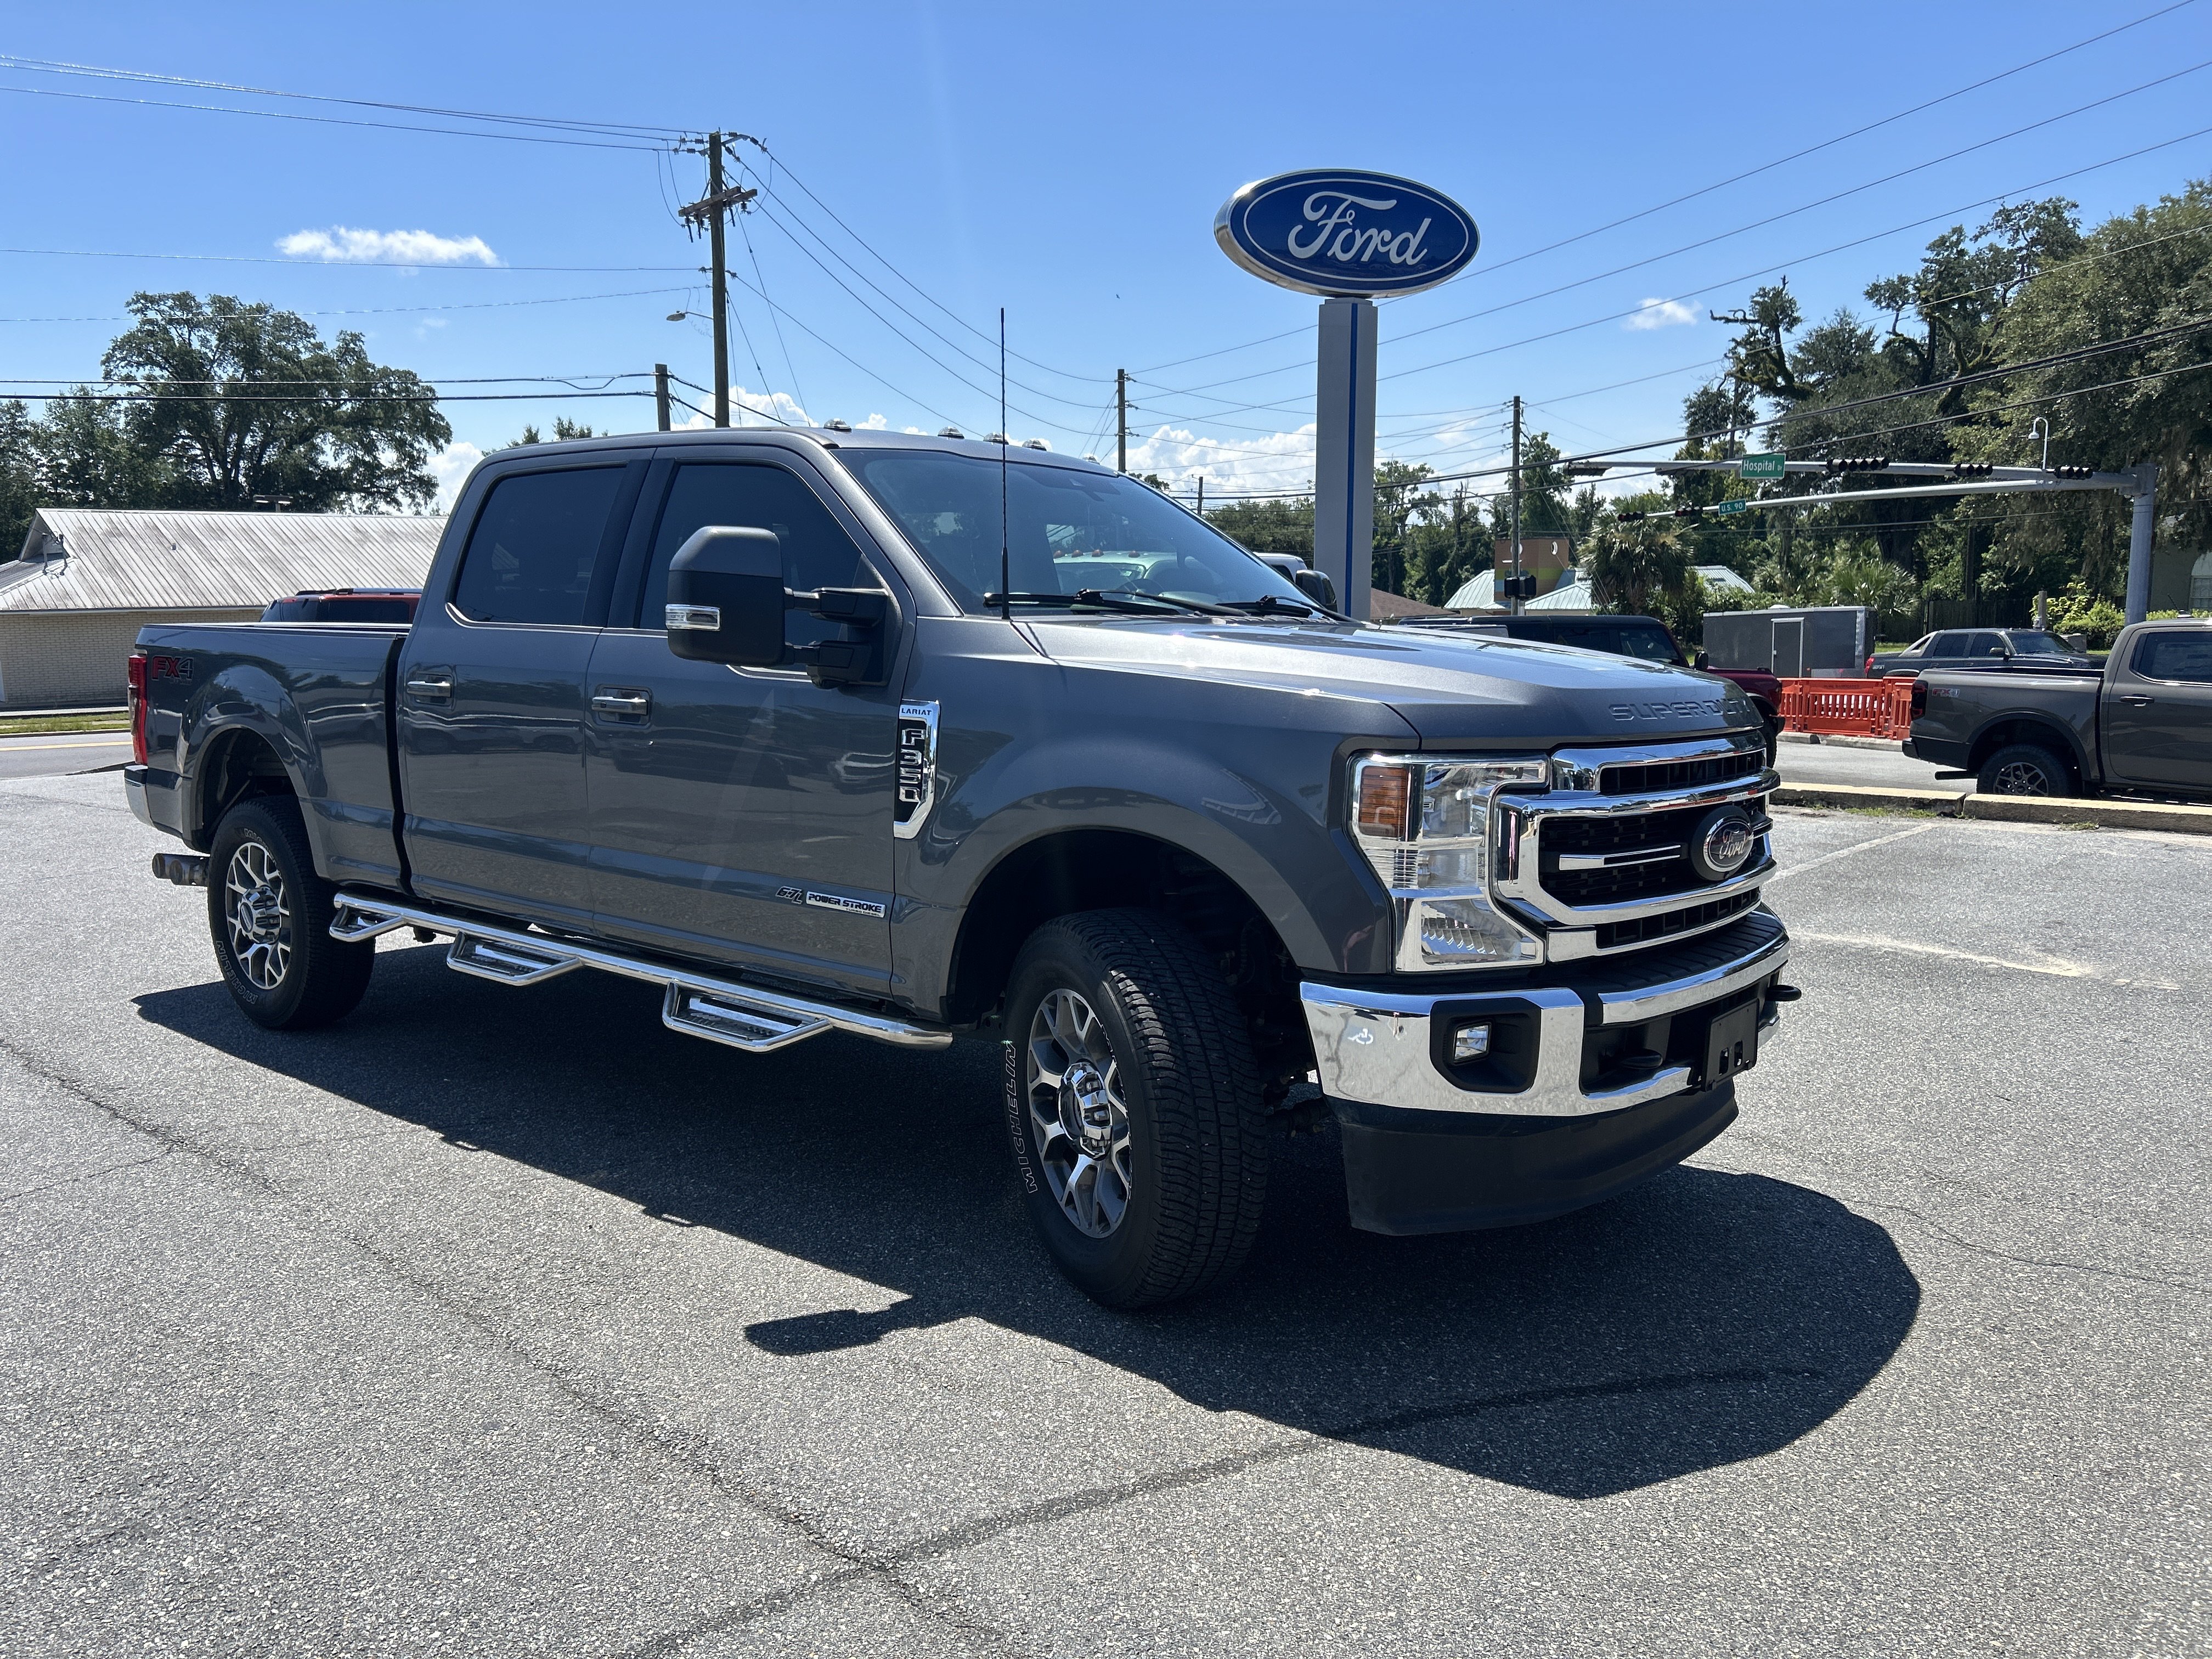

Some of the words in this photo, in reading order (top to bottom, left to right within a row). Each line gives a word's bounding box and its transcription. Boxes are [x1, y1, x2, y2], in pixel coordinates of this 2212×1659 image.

[1288, 191, 1431, 266] Ford
[1743, 460, 1775, 473] Hospital
[1721, 504, 1732, 512] U.S.
[1734, 502, 1743, 510] 90
[152, 655, 194, 681] FX4
[1932, 688, 1960, 697] FX4
[901, 707, 932, 716] LARIAT
[1609, 701, 1707, 721] SUPER
[1719, 828, 1747, 860] Ford
[808, 893, 840, 905] POWER
[842, 900, 882, 913] STROKE
[216, 941, 258, 1005] MICHELIN
[1005, 1042, 1038, 1194] MICHELIN
